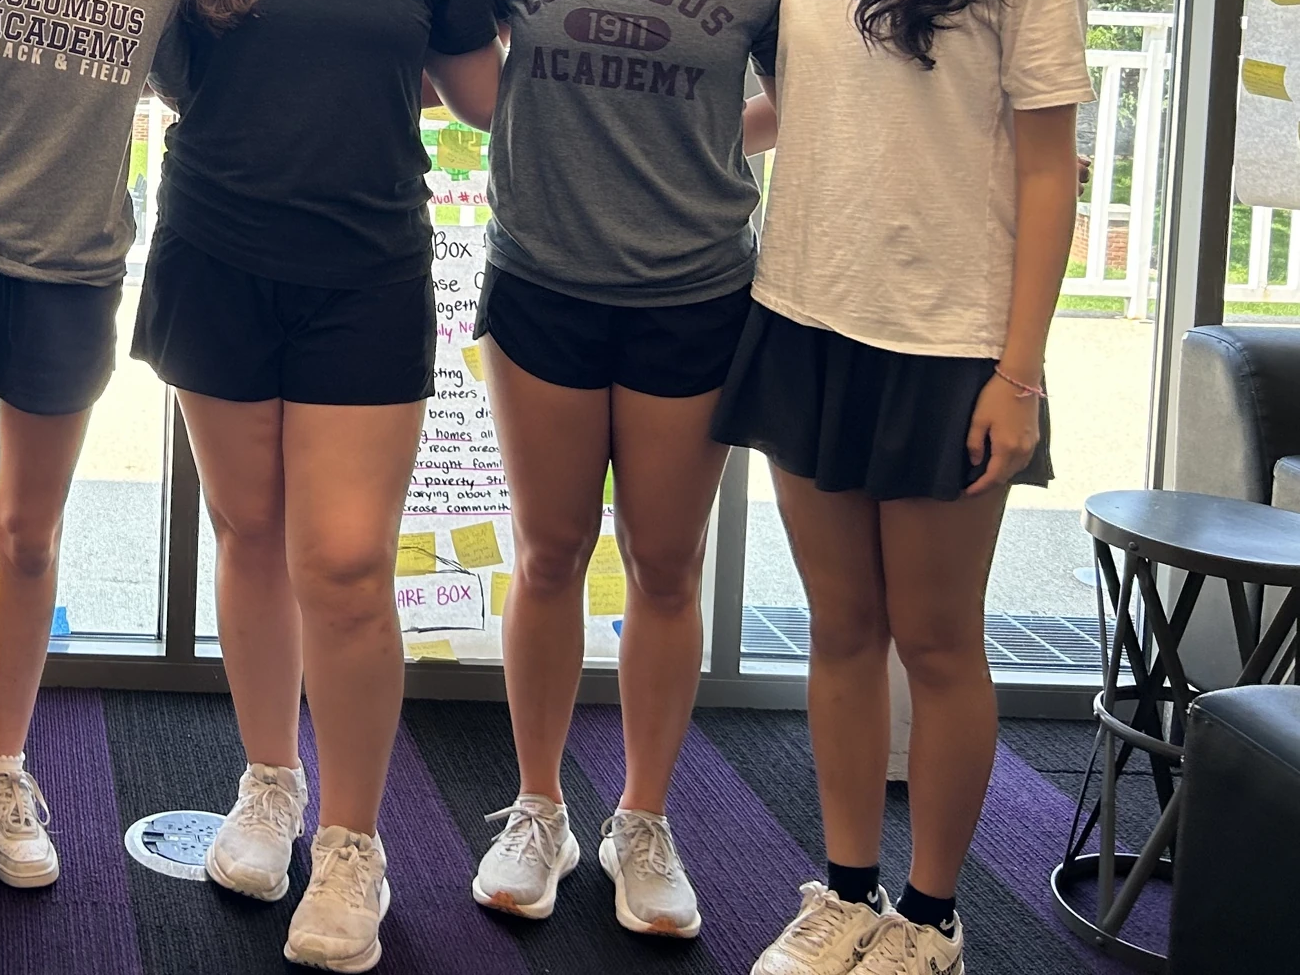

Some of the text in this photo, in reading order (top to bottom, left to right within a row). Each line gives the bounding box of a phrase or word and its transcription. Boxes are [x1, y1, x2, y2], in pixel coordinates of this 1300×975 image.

[587, 12, 649, 47] 1911
[54, 53, 68, 71] &
[79, 59, 131, 86] FIELD
[531, 46, 706, 100] ACADEMY
[429, 408, 465, 425] being
[436, 429, 472, 441] homes
[429, 444, 461, 453] reach
[425, 476, 475, 491] poverty
[457, 489, 492, 499] about
[397, 585, 472, 609] ARE BOX
